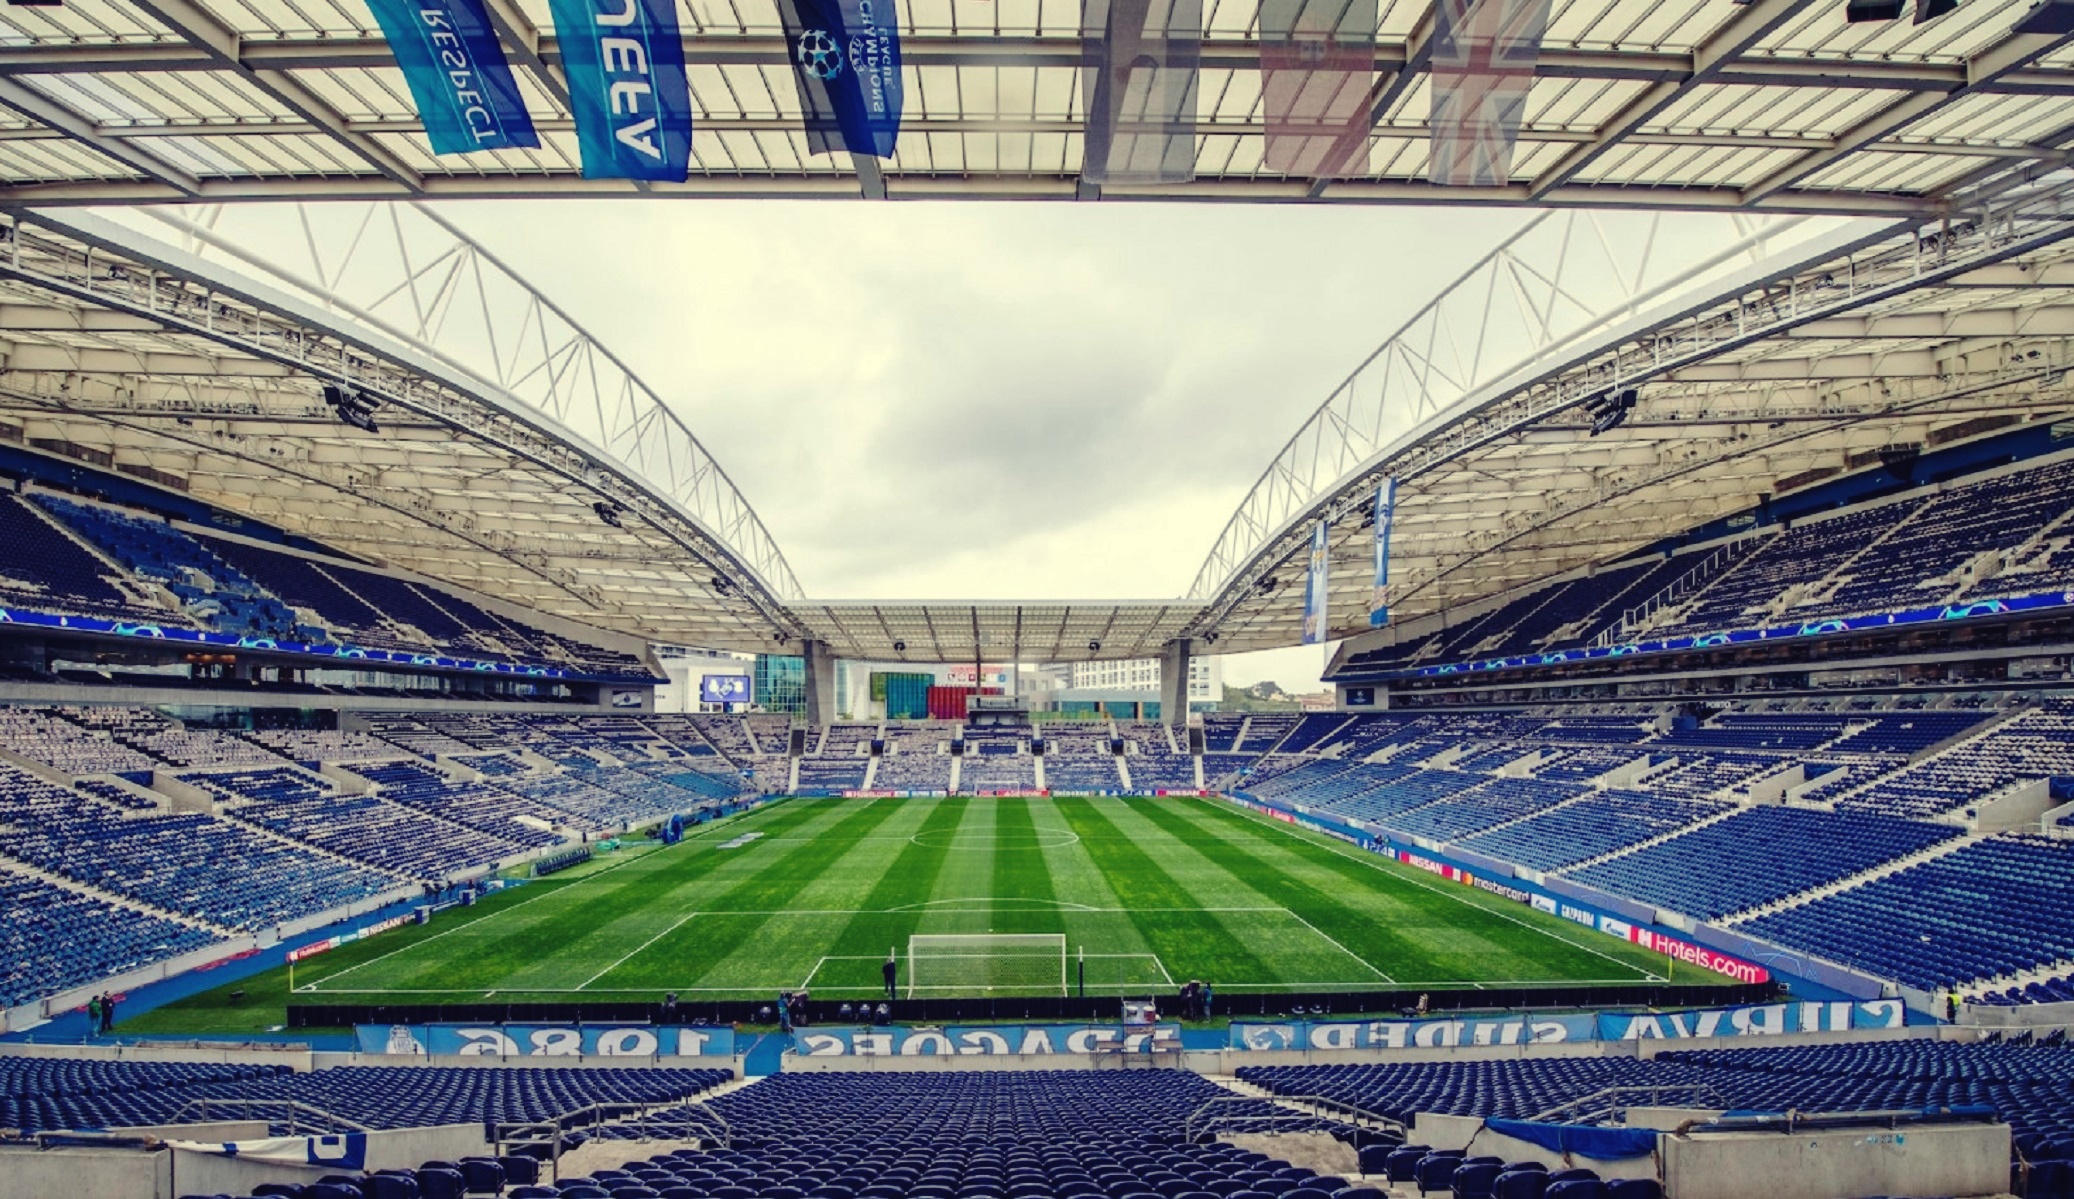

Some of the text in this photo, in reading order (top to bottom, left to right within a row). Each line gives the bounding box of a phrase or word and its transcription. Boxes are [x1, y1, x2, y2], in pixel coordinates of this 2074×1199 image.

[1408, 854, 1443, 875] NISSAN
[1473, 876, 1530, 902] mastercard
[368, 917, 401, 935] NISSAN
[1655, 934, 1757, 984] Hotels.com
